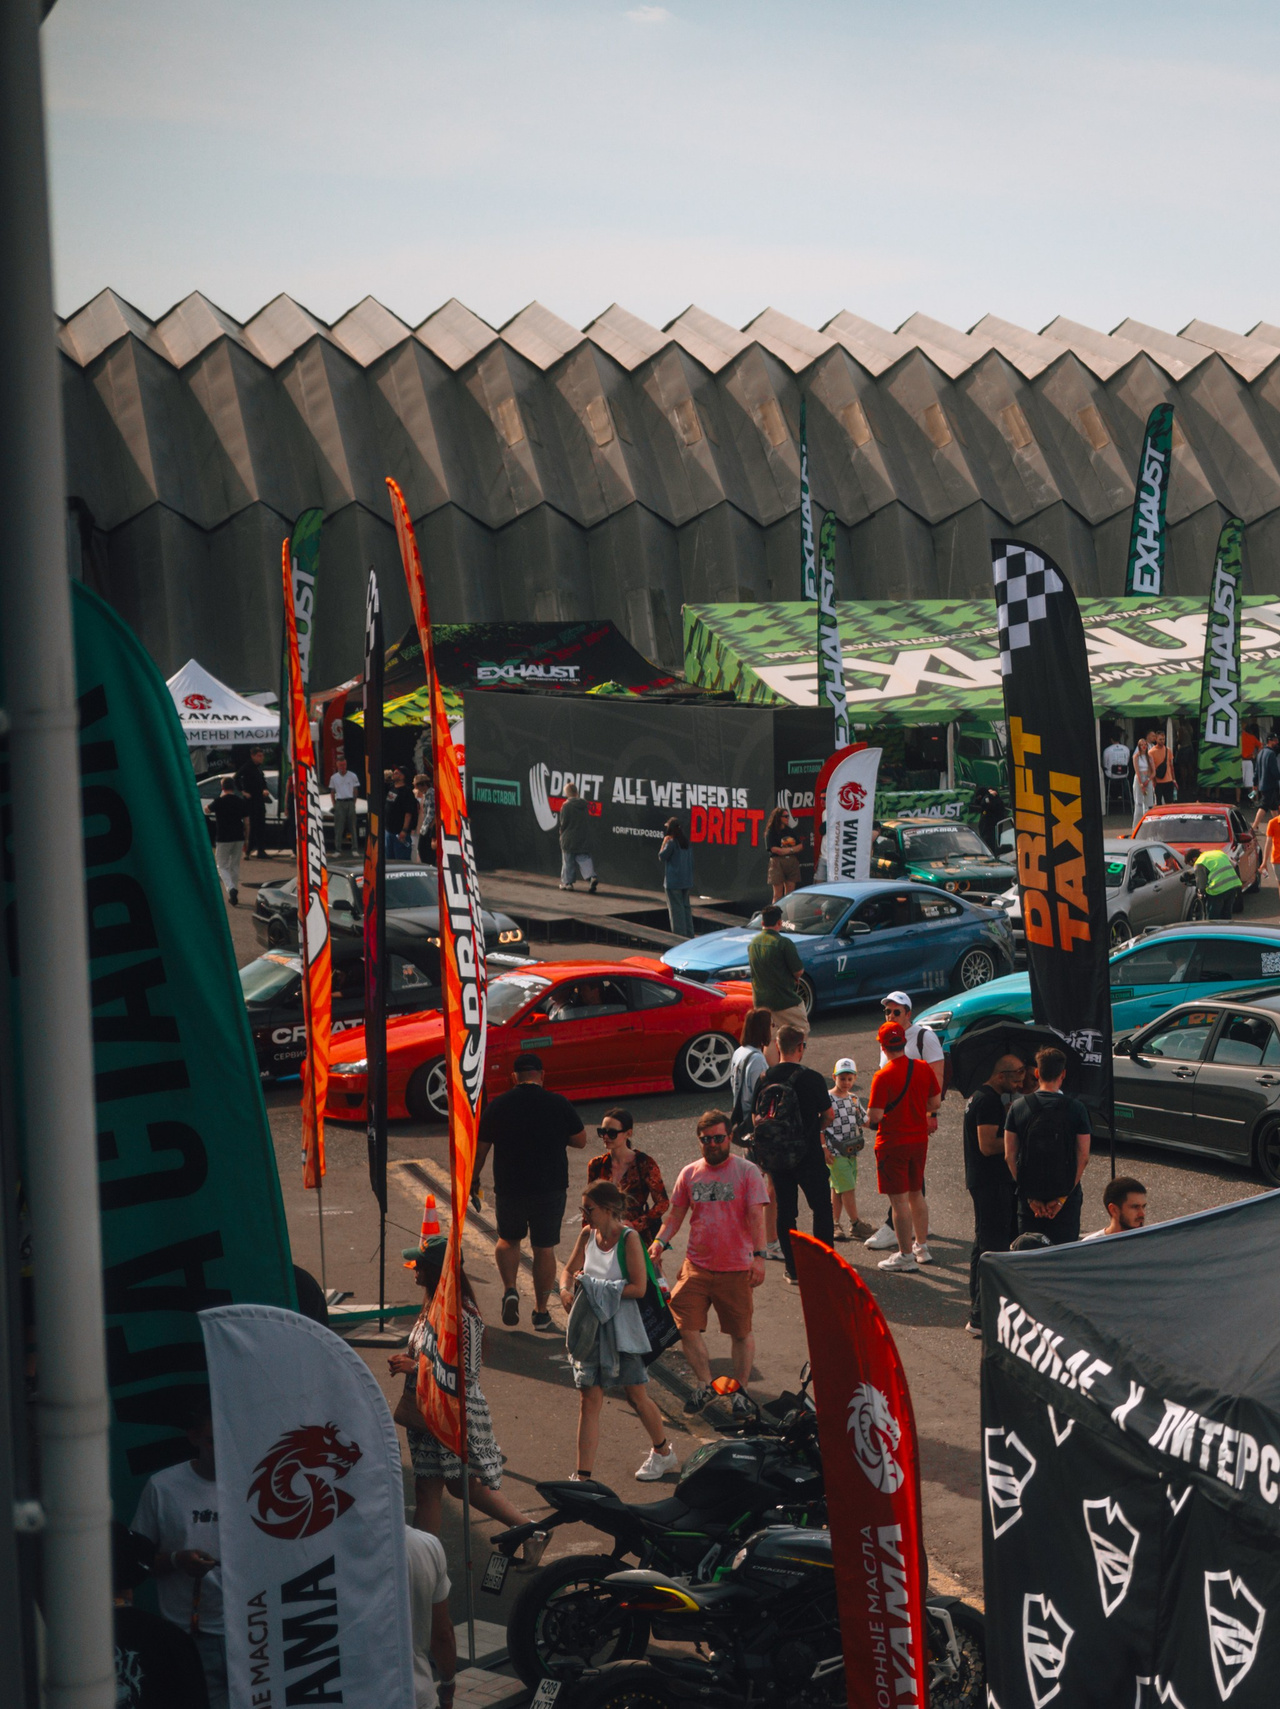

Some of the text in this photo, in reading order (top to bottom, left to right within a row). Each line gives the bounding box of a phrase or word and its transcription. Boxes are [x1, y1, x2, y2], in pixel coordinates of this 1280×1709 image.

[1133, 437, 1166, 595] EXHAUST
[477, 665, 581, 680] EXHAUST
[820, 556, 850, 750] EXHAUST
[1089, 659, 1204, 685] OMOTIVE
[1205, 558, 1238, 747] EXHAUST
[184, 731, 230, 742] АМЕНЫ
[476, 787, 517, 804] ЛИГА СТАВОК
[612, 776, 649, 805] ALL
[650, 779, 685, 808] WE
[685, 783, 730, 811] NEED
[732, 787, 750, 809] IS
[690, 805, 765, 847] DRIFT
[841, 818, 859, 880] AYAMA
[1009, 715, 1055, 949] DRIFT
[1049, 770, 1092, 953] TAXI
[1107, 862, 1123, 874] 9
[441, 826, 481, 1025] DRIFT
[837, 955, 848, 972] 17
[752, 1564, 806, 1577] DRAGSTER
[247, 1589, 272, 1685] МАСЛА
[860, 1525, 891, 1709] ОРНЫЕ МАСЛА
[877, 1523, 920, 1709] YAMA
[540, 1681, 558, 1695] 4209
